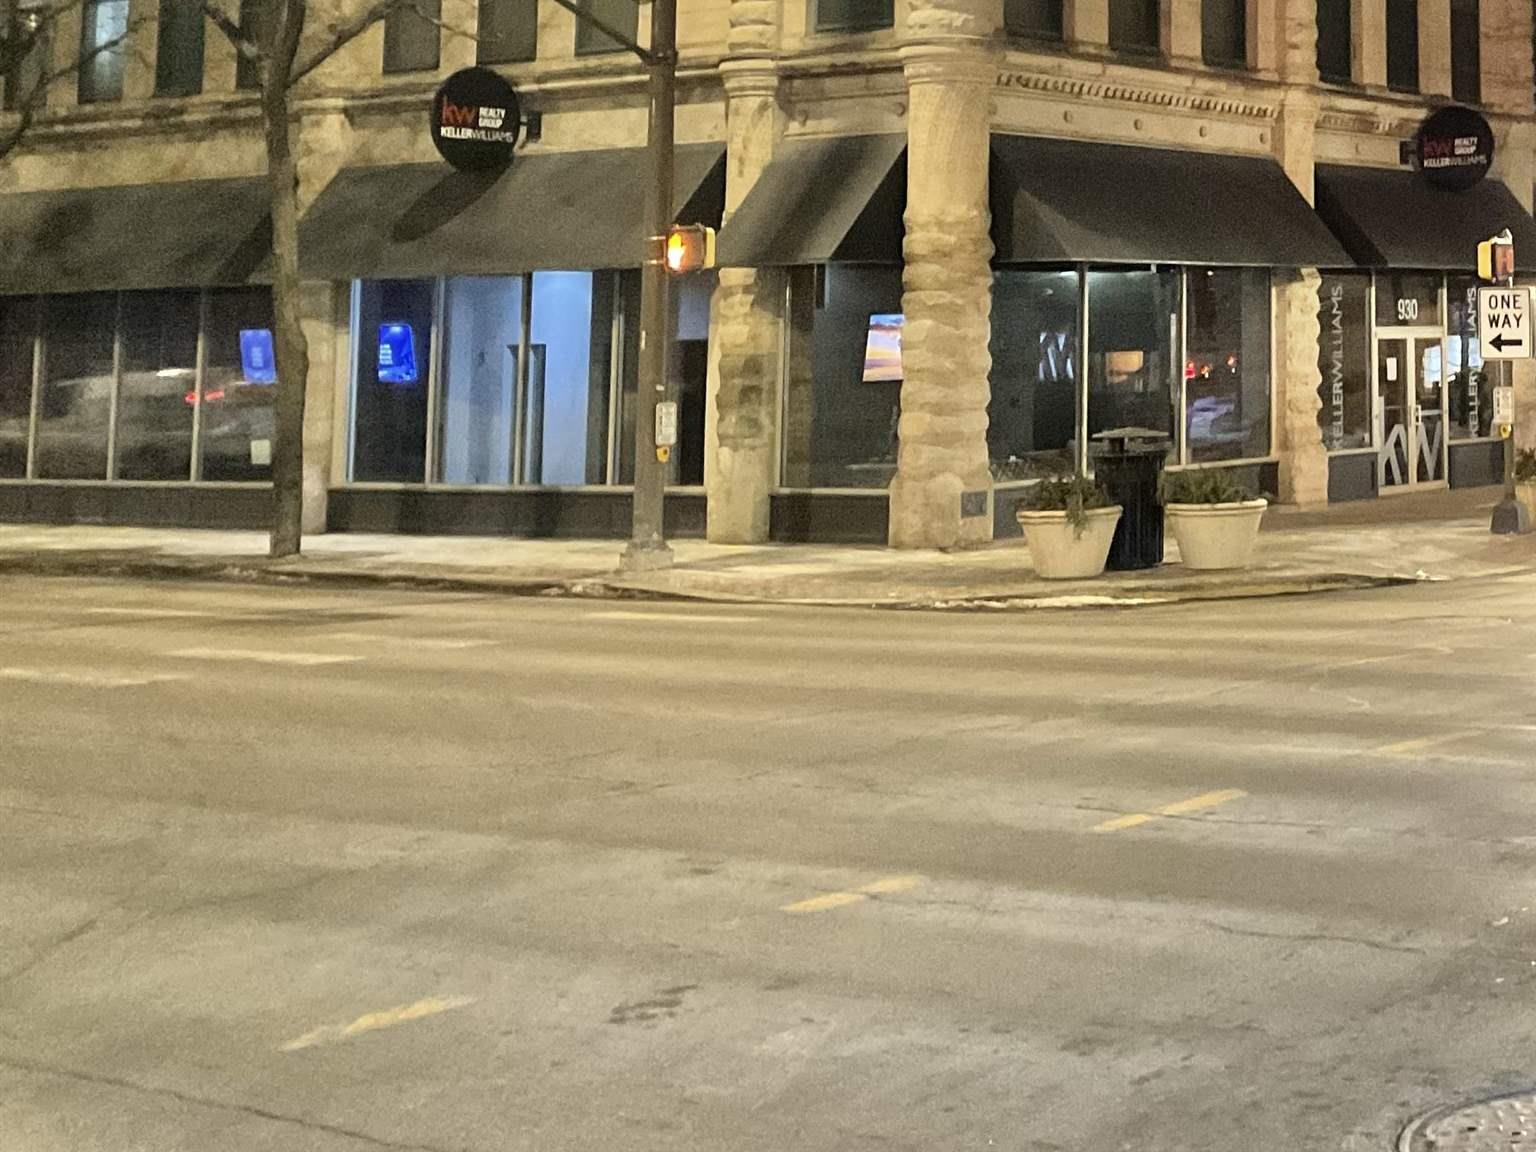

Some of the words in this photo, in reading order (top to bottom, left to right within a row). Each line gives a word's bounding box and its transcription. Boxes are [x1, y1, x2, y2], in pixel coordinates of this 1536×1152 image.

[479, 106, 506, 118] REALTY
[1397, 299, 1418, 320] 930
[1488, 294, 1522, 310] ONE
[1488, 313, 1523, 328] WAY
